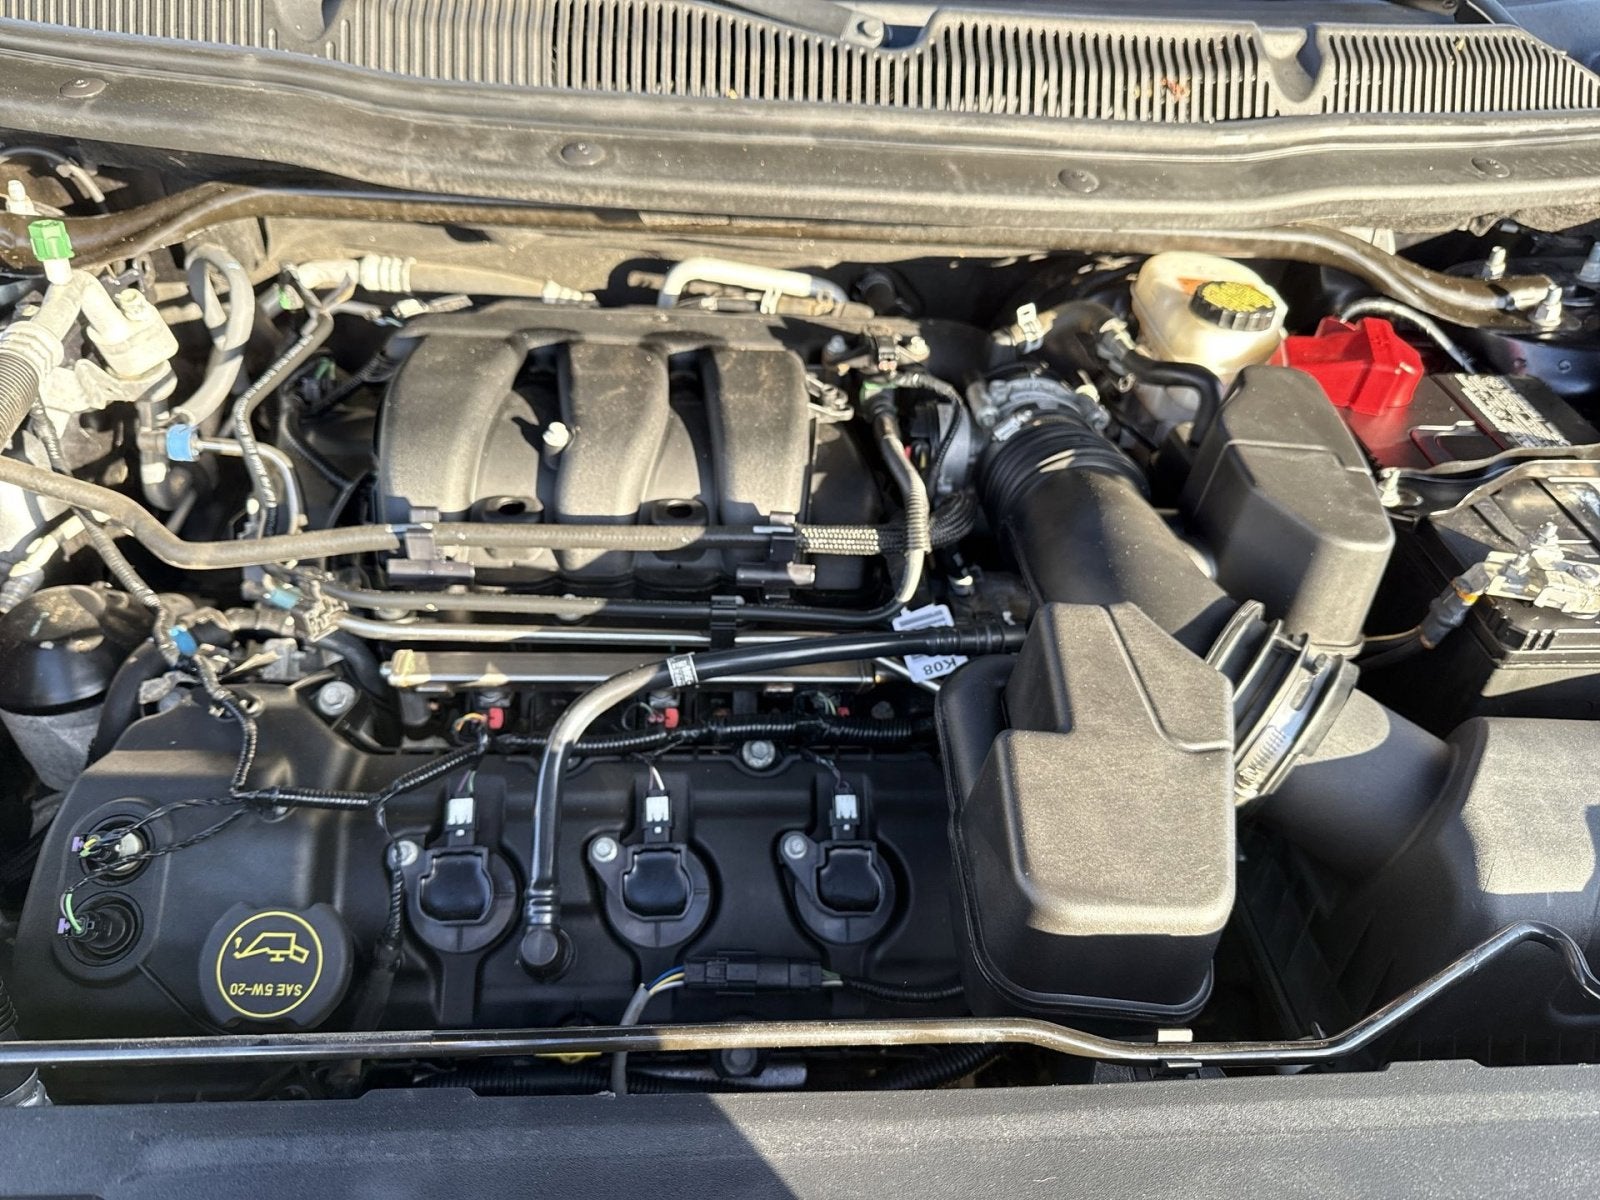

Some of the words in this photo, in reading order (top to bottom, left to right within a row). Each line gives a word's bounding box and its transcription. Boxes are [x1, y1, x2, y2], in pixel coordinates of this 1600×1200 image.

[923, 657, 957, 676] K08
[229, 982, 274, 996] 5W-20
[276, 983, 303, 997] SAE
